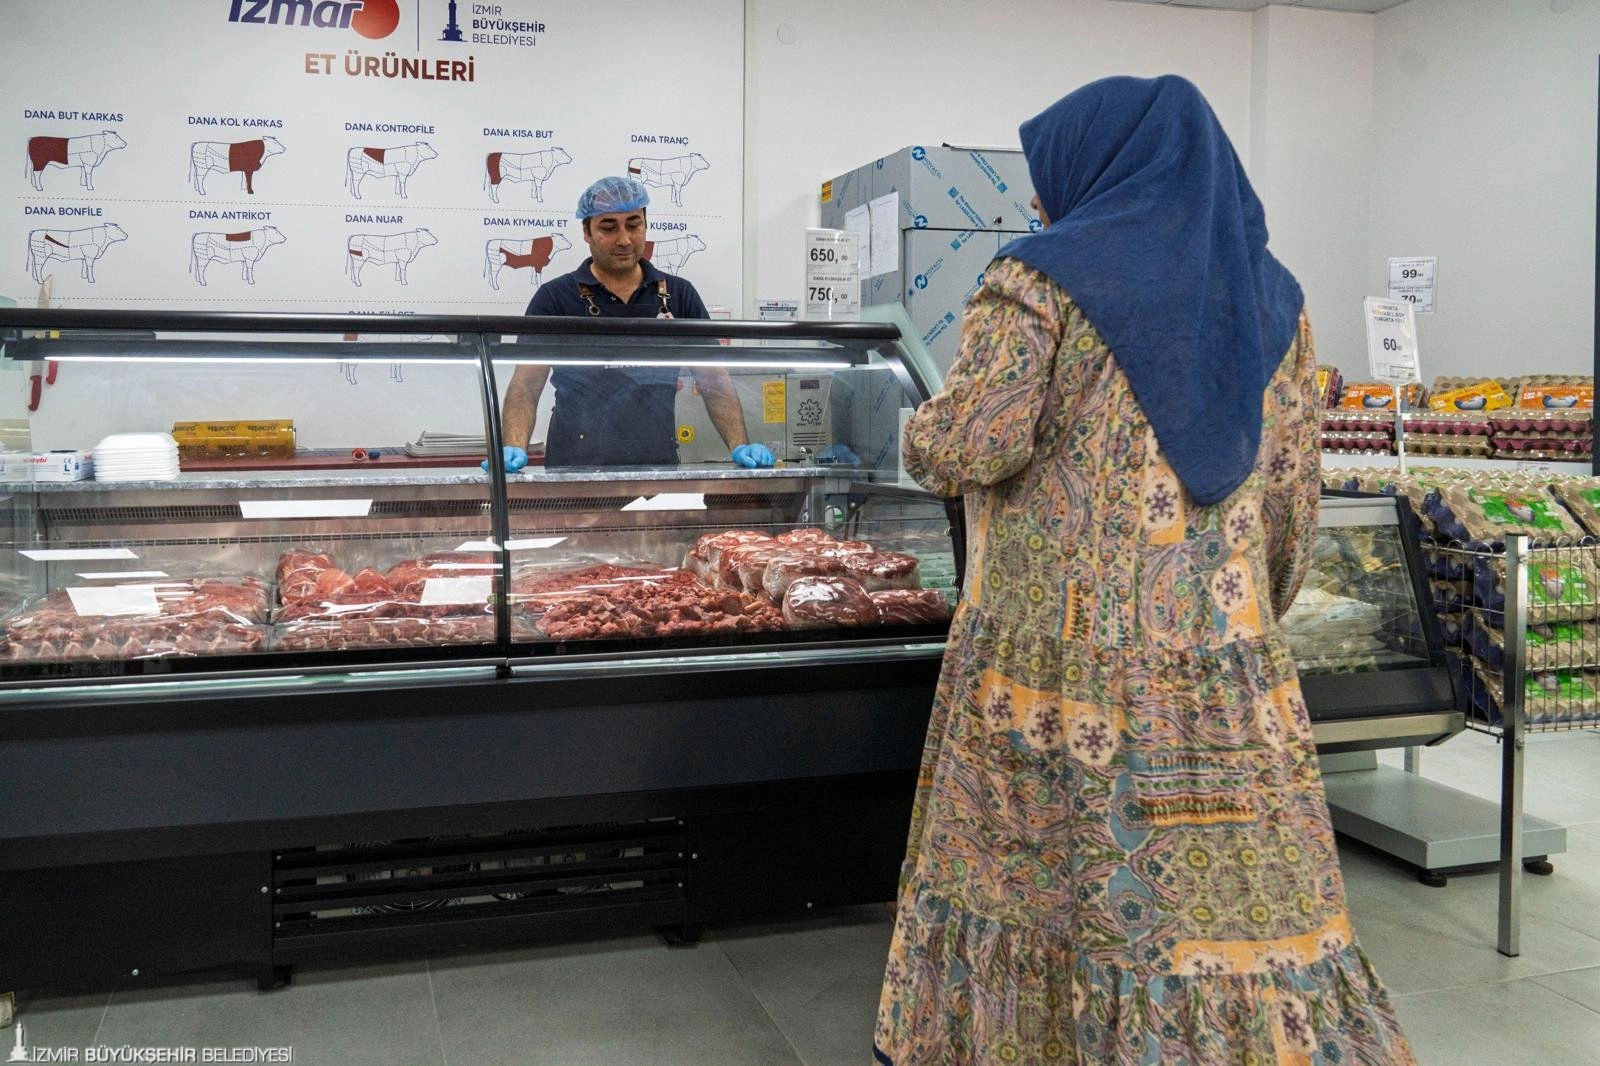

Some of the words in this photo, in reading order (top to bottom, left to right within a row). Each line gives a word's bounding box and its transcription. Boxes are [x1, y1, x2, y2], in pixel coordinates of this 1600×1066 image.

[472, 3, 502, 16] İZMİR
[472, 18, 546, 34] BÜYÜKŞEHİR
[472, 33, 536, 47] BELEDİYESİ
[305, 53, 336, 75] ET
[344, 50, 475, 82] ÜRÜNLERİ
[24, 109, 56, 120] DANA
[58, 111, 79, 121] BUT
[81, 112, 124, 122] KARKAS
[188, 116, 218, 126] DANA
[220, 117, 241, 127] KOL
[243, 118, 283, 129] KARKAS
[344, 122, 373, 132] DANA
[375, 123, 435, 135] KONTROFİLE
[483, 127, 511, 137] DANA
[512, 129, 534, 139] KISA
[535, 130, 554, 139] BUT
[631, 134, 657, 144] DANA
[659, 135, 689, 147] TRANÇ
[24, 206, 56, 216] DANA
[58, 205, 103, 217] BONFİLE
[189, 210, 219, 220] DANA
[221, 209, 272, 221] ANTRİKOT
[345, 214, 374, 224] DANA
[375, 215, 403, 225] NUAR
[483, 217, 511, 227] DANA
[512, 218, 556, 228] KIYMALIK
[557, 218, 569, 228] ET
[650, 222, 687, 232] KUŞBAŞI
[1402, 269, 1417, 278] 99
[1383, 337, 1397, 351] 60
